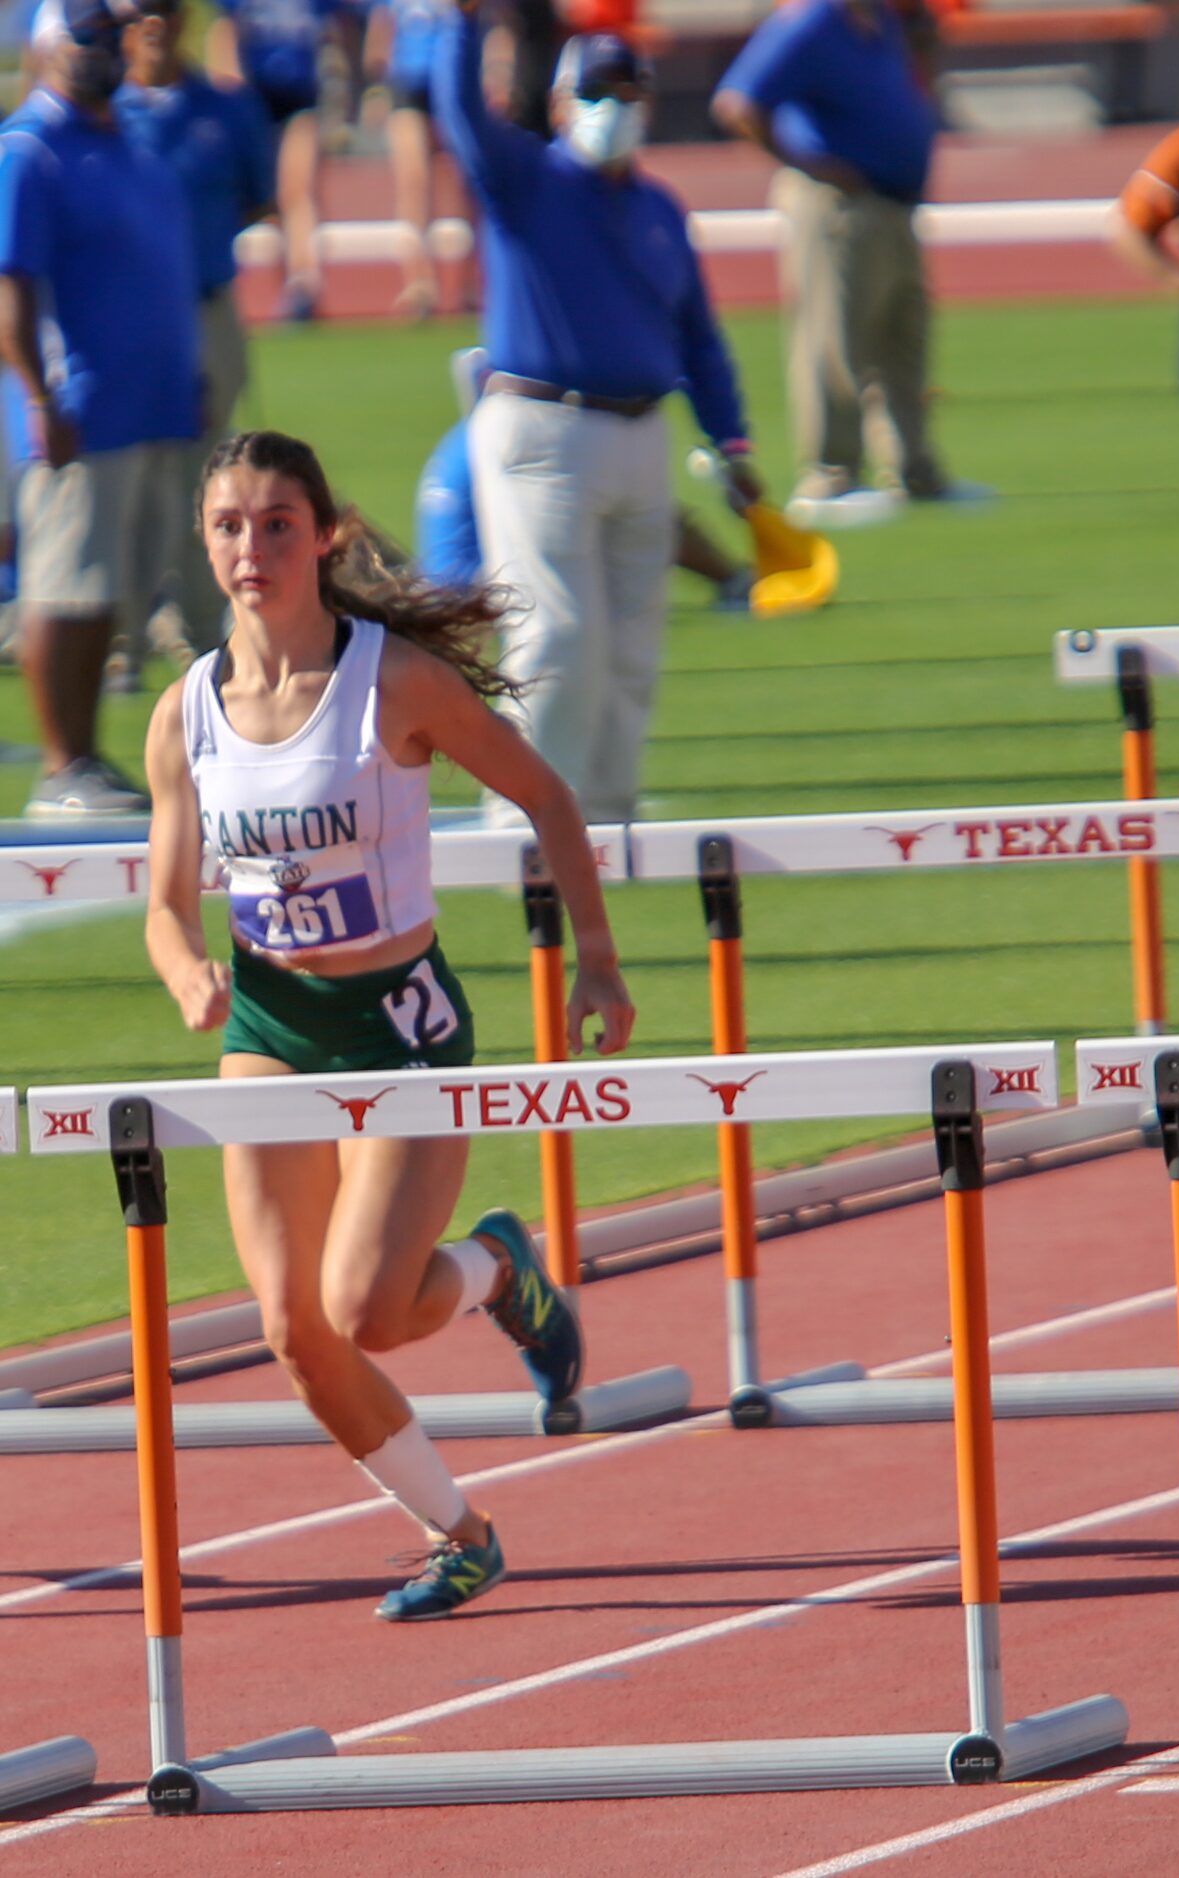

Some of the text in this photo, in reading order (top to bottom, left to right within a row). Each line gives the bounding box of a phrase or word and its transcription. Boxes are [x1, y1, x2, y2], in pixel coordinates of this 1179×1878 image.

[954, 812, 1156, 858] TEXAS
[257, 887, 347, 948] 261
[391, 976, 448, 1046] 2
[989, 1065, 1042, 1094] XII
[1091, 1061, 1142, 1090] XII
[42, 1107, 94, 1138] XII
[440, 1078, 630, 1128] TEXAS
